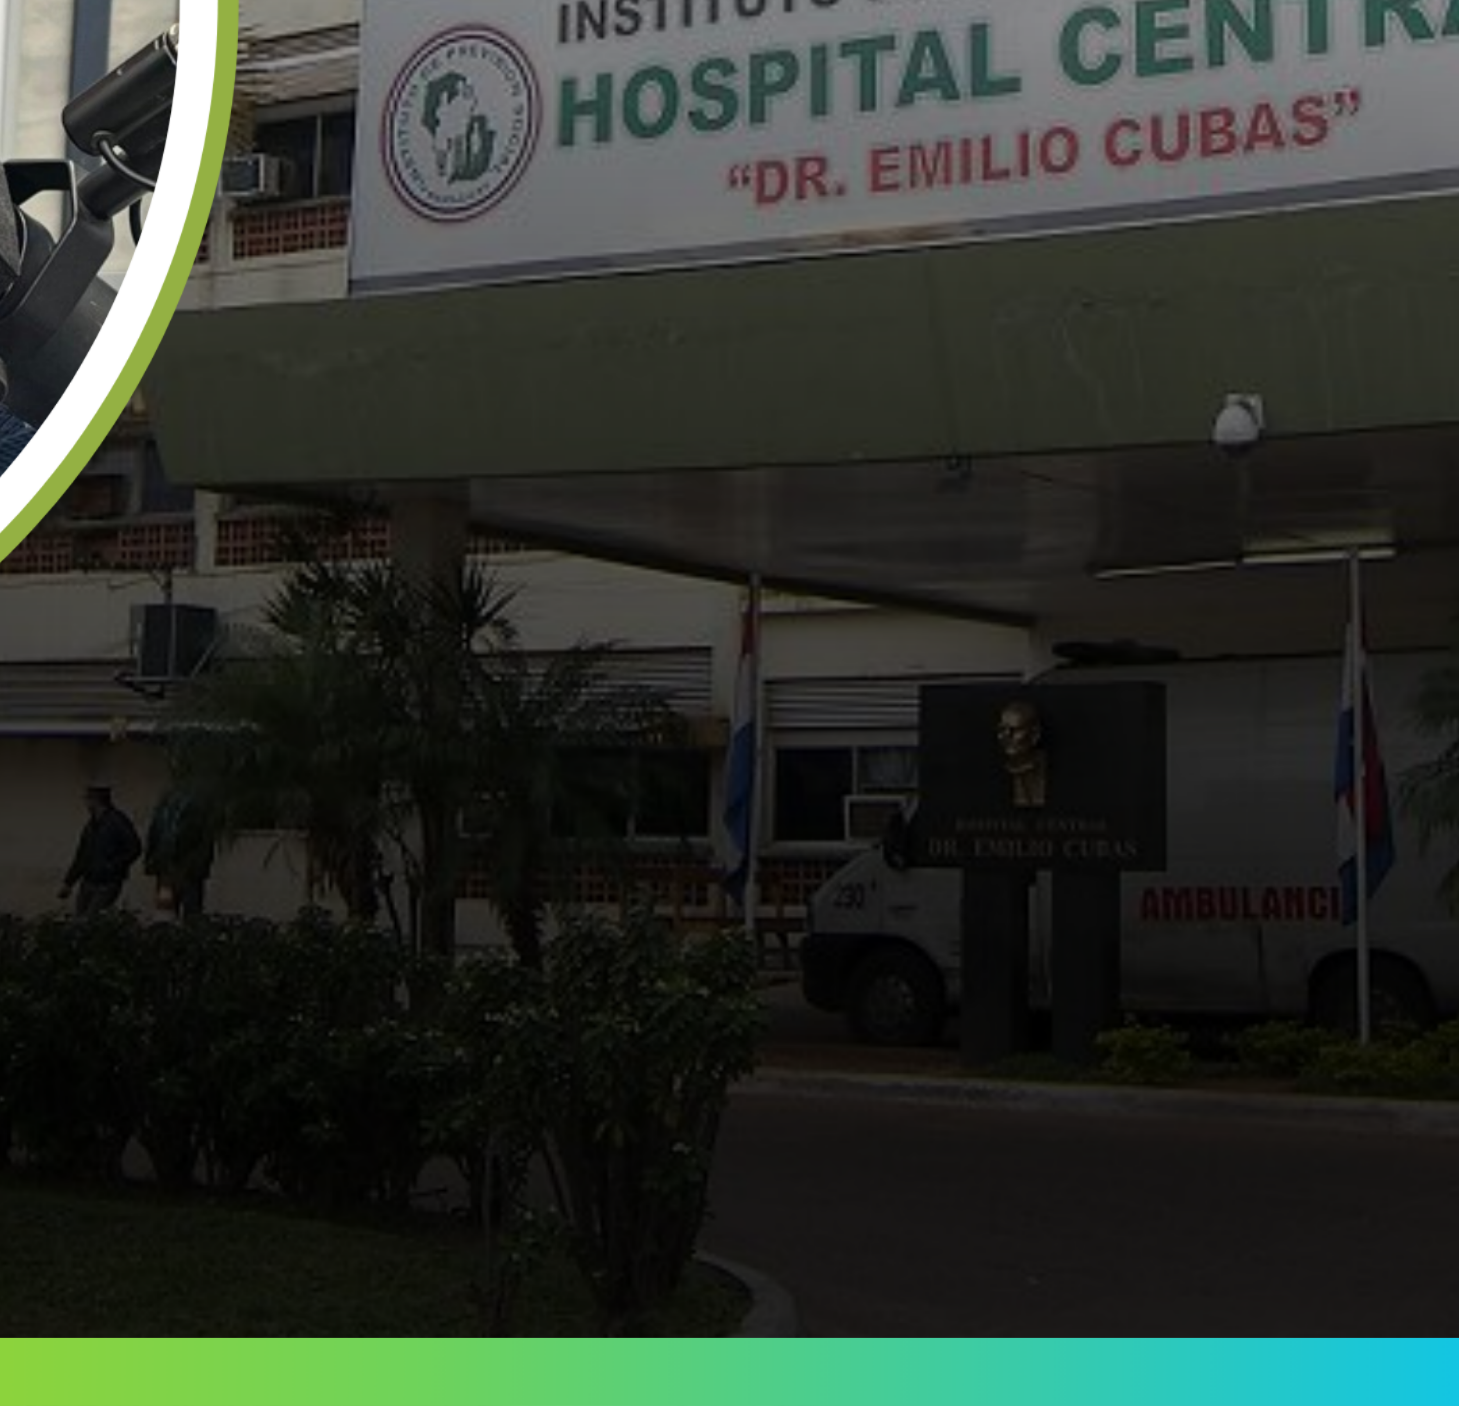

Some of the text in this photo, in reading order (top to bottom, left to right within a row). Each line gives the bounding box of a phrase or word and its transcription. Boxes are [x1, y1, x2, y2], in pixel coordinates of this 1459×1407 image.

[558, 23, 1022, 146] HOSPITAL
[727, 86, 1361, 206] “DR. EMILIO CUBAS”
[973, 837, 1054, 858] EMILIO
[1062, 837, 1139, 858] CUBAS
[1140, 886, 1341, 922] AMBULANCI
